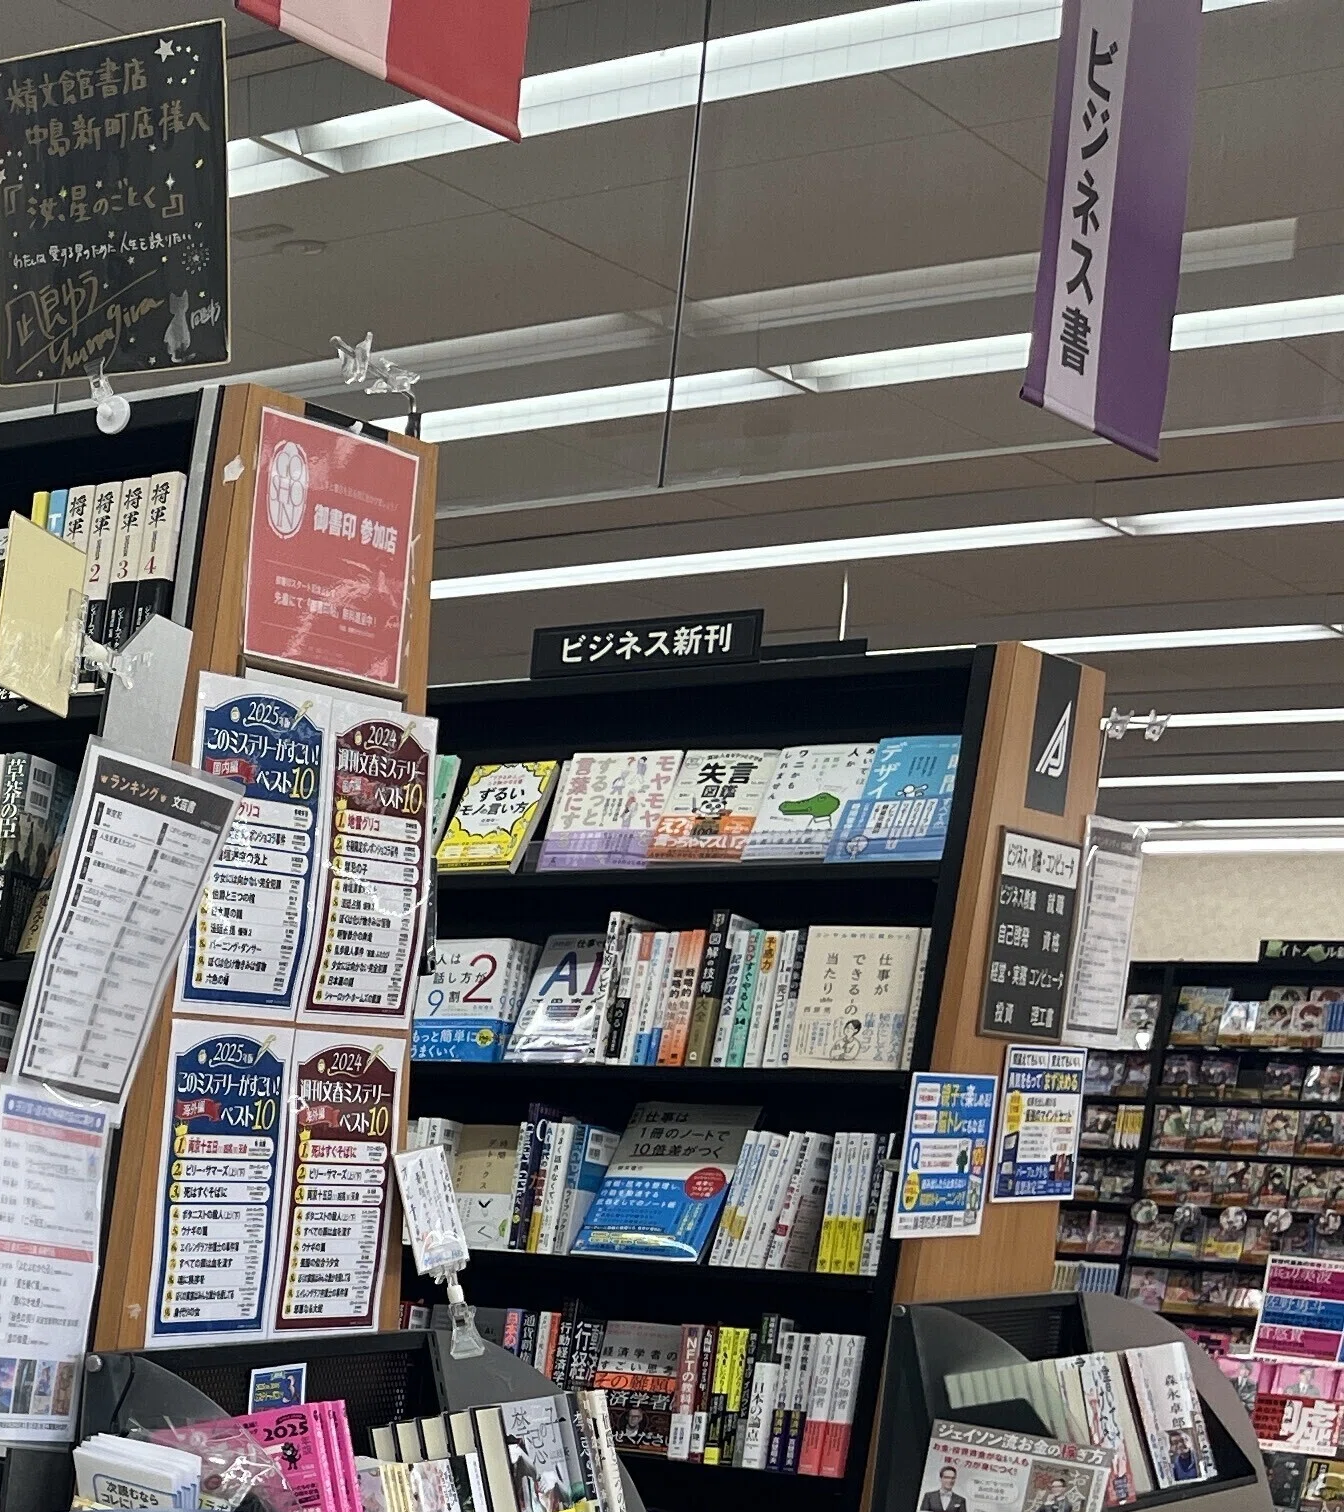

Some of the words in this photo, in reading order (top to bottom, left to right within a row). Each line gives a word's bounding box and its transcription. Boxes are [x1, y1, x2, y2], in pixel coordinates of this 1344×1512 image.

[7, 58, 148, 115] 精文館書店
[25, 100, 211, 157] 中島新町店様へ
[1060, 27, 1119, 377] ビジネス書
[65, 495, 88, 539] 将軍
[92, 492, 115, 536] 将軍
[89, 563, 100, 583] 2
[116, 560, 130, 581] 3
[560, 623, 734, 666] ビジネス新刊
[206, 729, 320, 767] このミステリーがすごい!
[367, 725, 397, 749] 2024
[337, 749, 426, 781] 週刊文春ミステリー
[696, 760, 758, 786] 失言
[256, 767, 315, 800] ベスト10
[478, 784, 527, 803] ずるい
[375, 784, 424, 814] ベスト10
[996, 923, 1031, 950] 自己啓発
[1041, 932, 1060, 955] 資格
[461, 953, 498, 1004] 2
[1028, 966, 1064, 991] コンピュータ
[427, 988, 444, 1018] 9
[993, 1003, 1015, 1026] 投資
[1029, 1006, 1055, 1029] 理工書
[330, 1052, 362, 1072] 2024
[177, 1072, 281, 1098] このミステリーがすごい!
[299, 1079, 391, 1106] 週刊文春ミステリー
[220, 1099, 276, 1130] ベスト10
[339, 1106, 388, 1136] ベスト10
[644, 1110, 689, 1124] 仕事は
[639, 1126, 731, 1142] 1冊のノートで
[311, 1144, 357, 1160] 死はすぐそばに
[630, 1141, 722, 1159] 10倍差がつく
[183, 1184, 228, 1199] 死はすぐそばに
[602, 1346, 678, 1363] 経済学者の
[1162, 1371, 1188, 1428] 森永卓郎
[261, 1412, 310, 1443] 2025
[938, 1423, 1104, 1465] ジェイソン流お金の稼ぎ方
